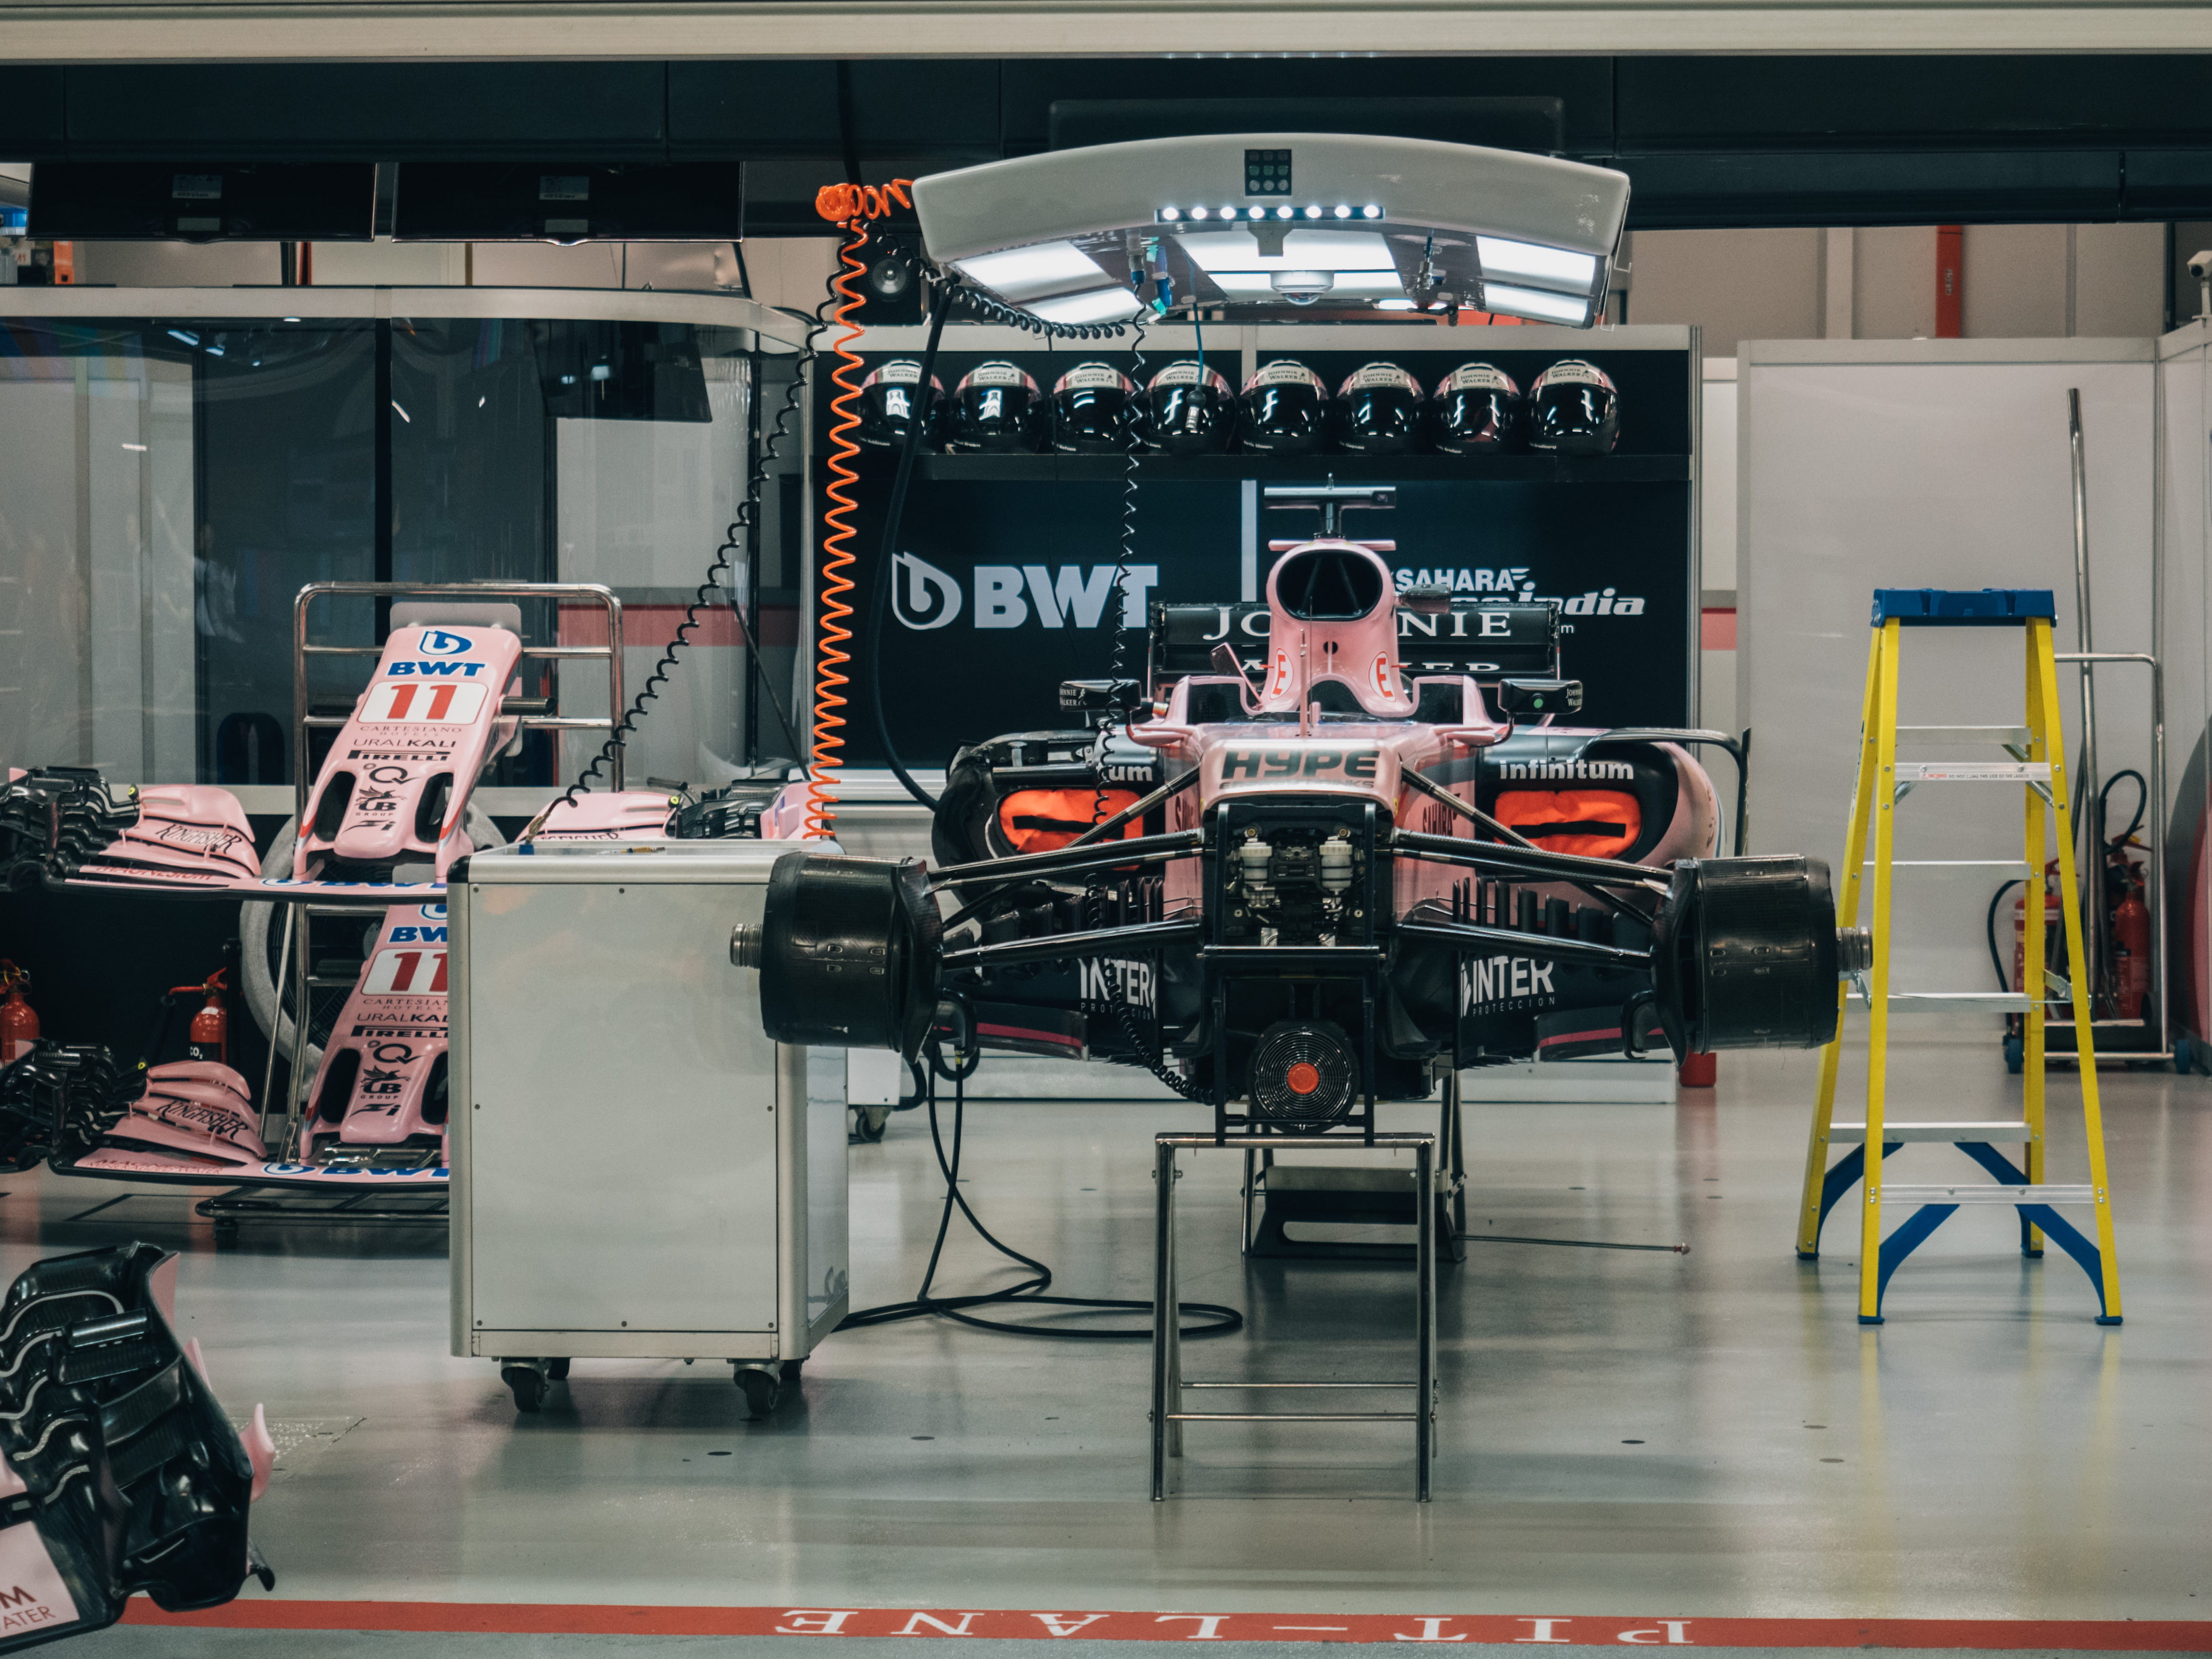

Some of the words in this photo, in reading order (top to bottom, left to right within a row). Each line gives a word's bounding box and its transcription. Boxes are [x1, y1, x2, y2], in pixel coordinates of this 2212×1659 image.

[1395, 568, 1515, 592] SAHARA
[974, 565, 1158, 628] BWT
[1202, 611, 1511, 641] JONIE
[387, 661, 485, 676] BWT
[387, 684, 458, 720] 11
[347, 749, 452, 761] PIRELLI
[353, 739, 457, 748] URALKALI
[1221, 750, 1380, 780] HYPE
[1499, 759, 1634, 780] infinitum
[154, 824, 243, 854] KINGFISHER
[389, 927, 448, 943] BW
[1077, 956, 1150, 1008] INTER
[1473, 955, 1555, 1004] INTER
[357, 1013, 448, 1022] URALKAL
[1081, 1002, 1151, 1020] PROTCION
[1473, 997, 1555, 1017] PROTECCION
[156, 1100, 249, 1140] KINGFISHER
[3, 1606, 56, 1630] ATER
